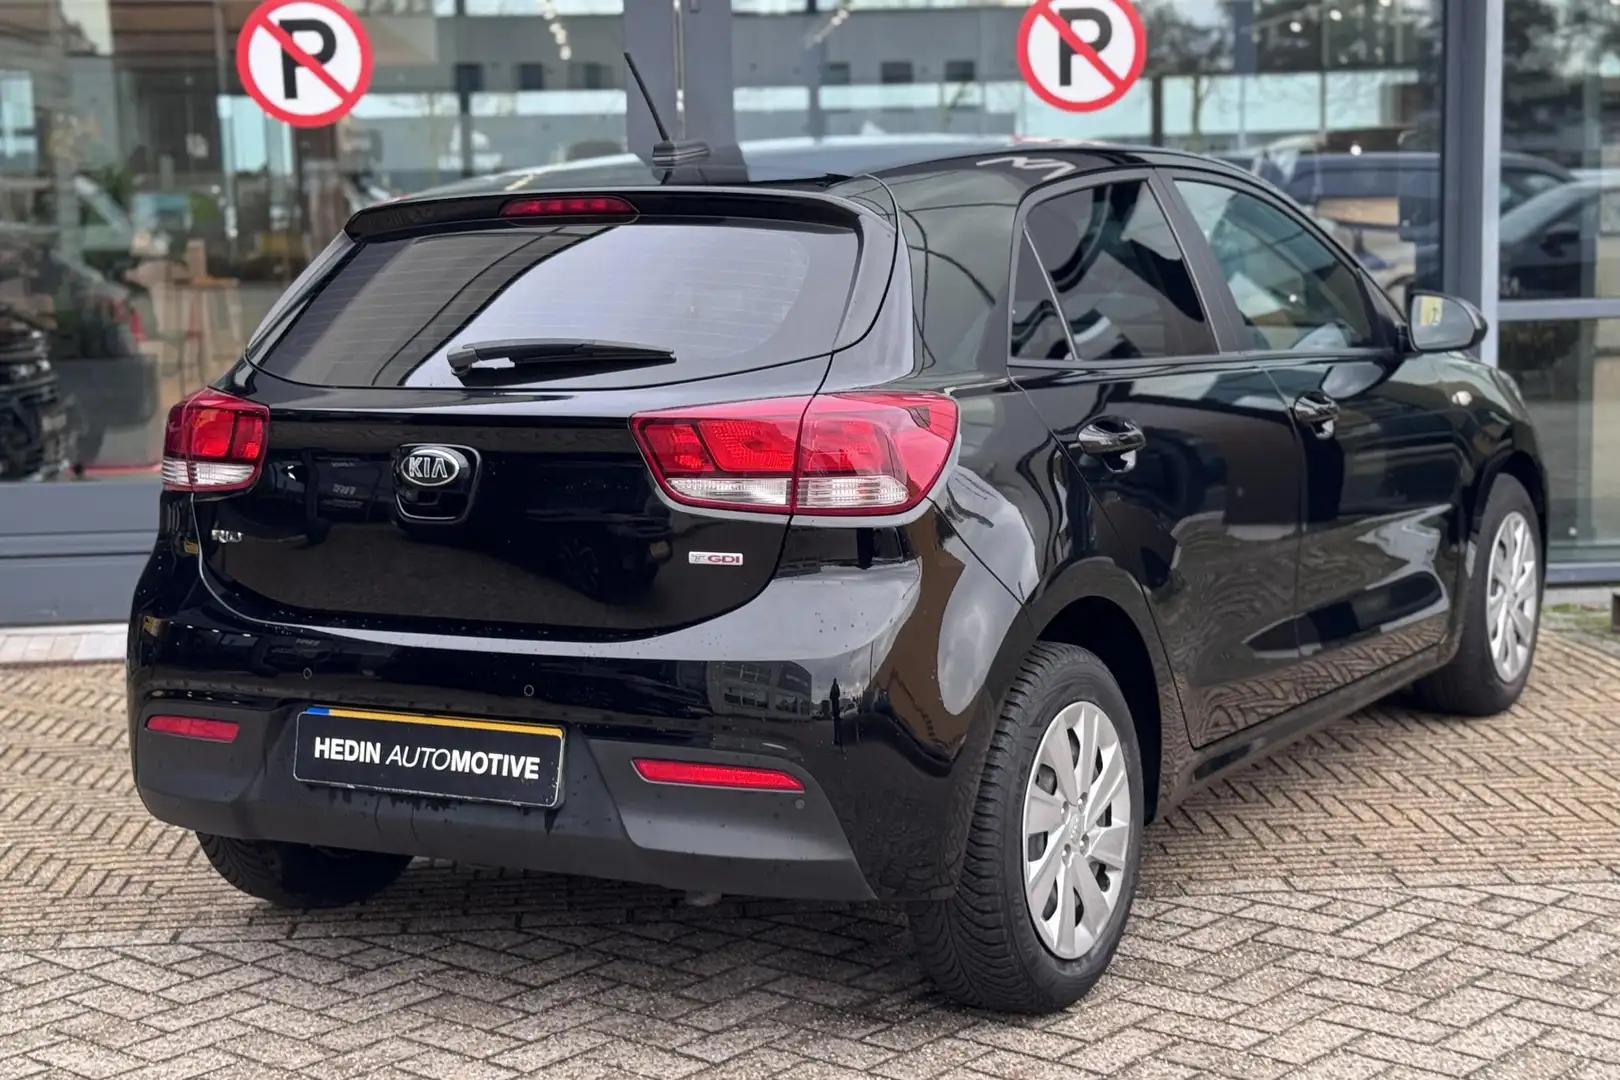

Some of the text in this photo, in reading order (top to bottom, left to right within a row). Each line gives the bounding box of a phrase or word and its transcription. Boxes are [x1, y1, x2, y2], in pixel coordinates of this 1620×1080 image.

[278, 19, 337, 100] P
[1058, 8, 1112, 87] P
[408, 456, 449, 478] KIA
[313, 736, 541, 780] HEDIN AUTOMOTIVE
